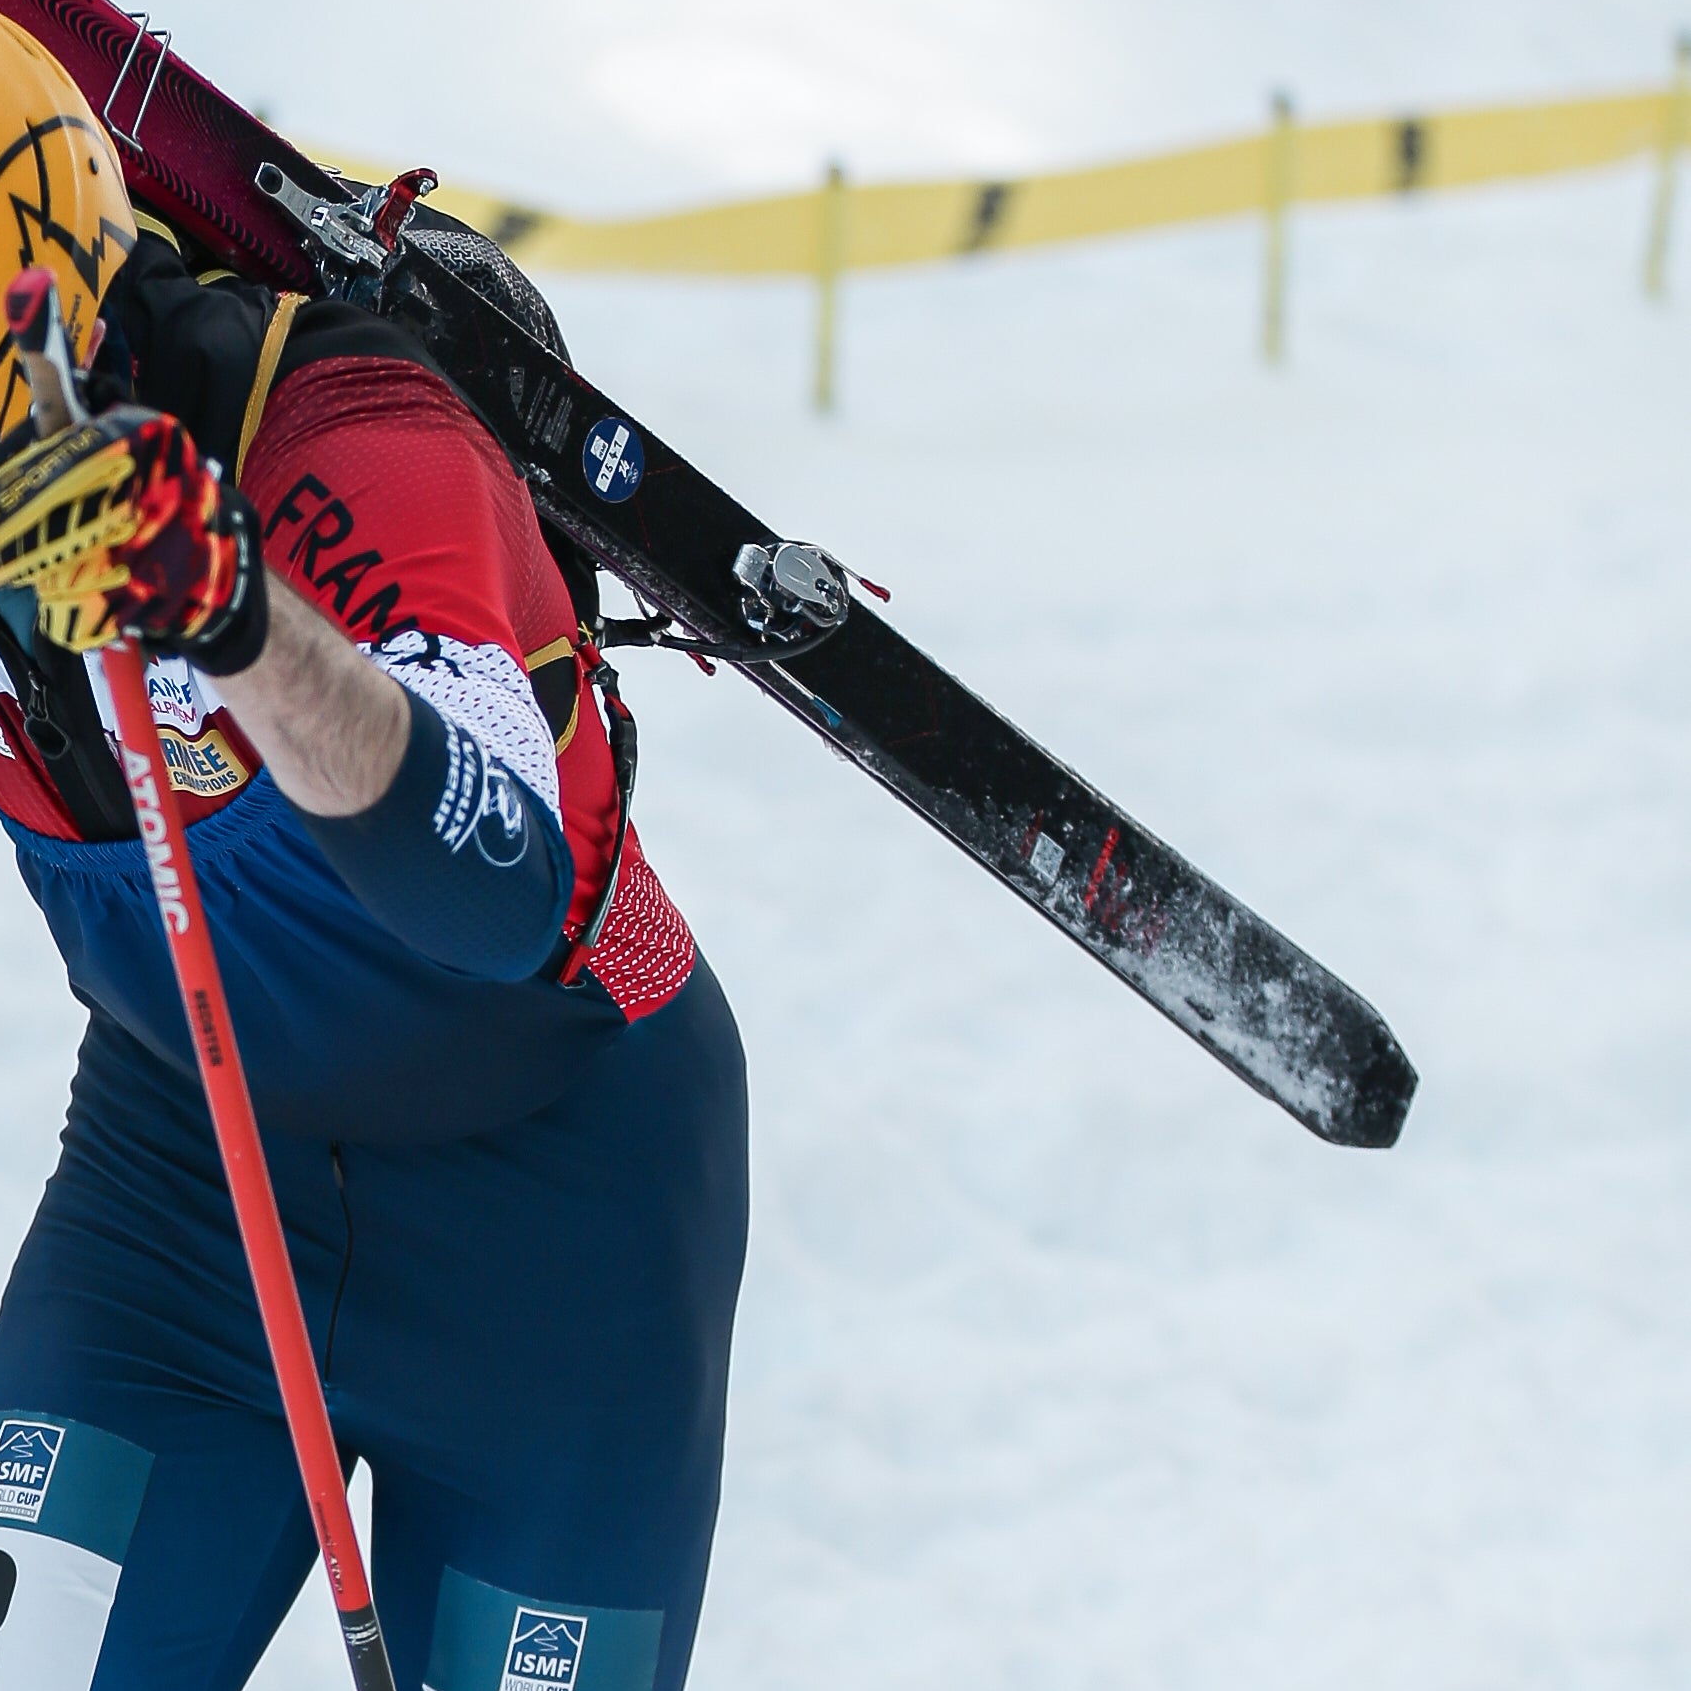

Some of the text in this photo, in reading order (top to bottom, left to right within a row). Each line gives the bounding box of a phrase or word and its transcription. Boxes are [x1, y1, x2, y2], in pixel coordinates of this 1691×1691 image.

[442, 740, 477, 846] Vieux
[120, 747, 191, 936] ATOMIC
[16, 1491, 41, 1507] CUP
[514, 1651, 572, 1679] ISMF
